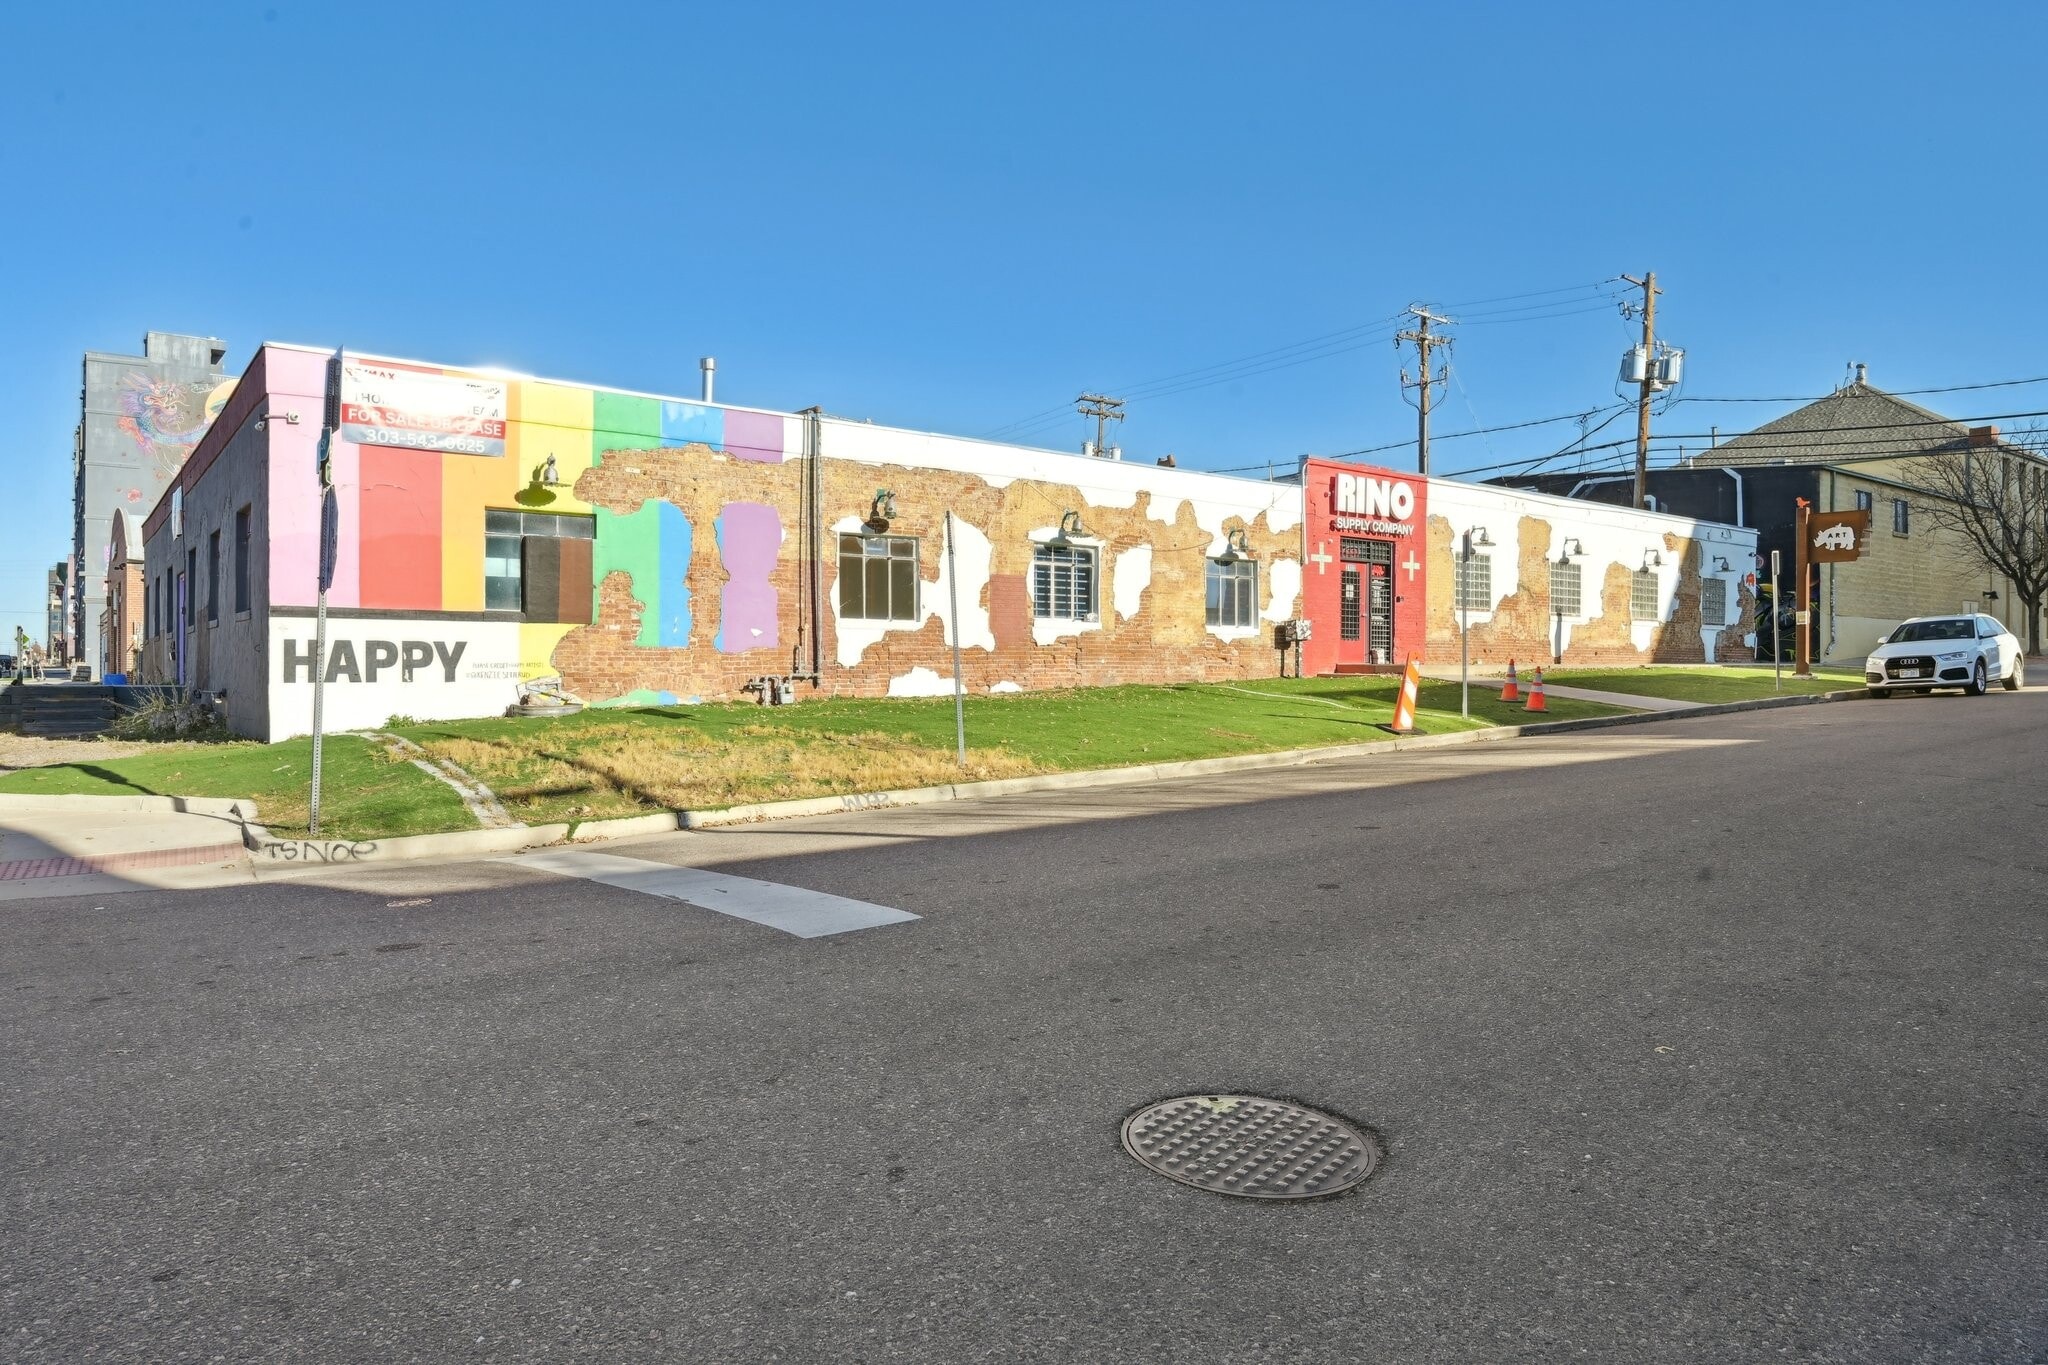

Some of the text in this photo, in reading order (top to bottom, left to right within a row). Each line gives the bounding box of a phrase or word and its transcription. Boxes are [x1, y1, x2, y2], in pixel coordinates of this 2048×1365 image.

[348, 408, 381, 424] FOR
[386, 412, 428, 427] SALE
[429, 417, 452, 429] OR
[366, 428, 486, 453] 303-543-0625
[1334, 473, 1415, 521] RINO
[1336, 517, 1415, 536] SUPPLY COMPANY
[1827, 531, 1848, 539] ART
[283, 638, 468, 683] HAPPY
